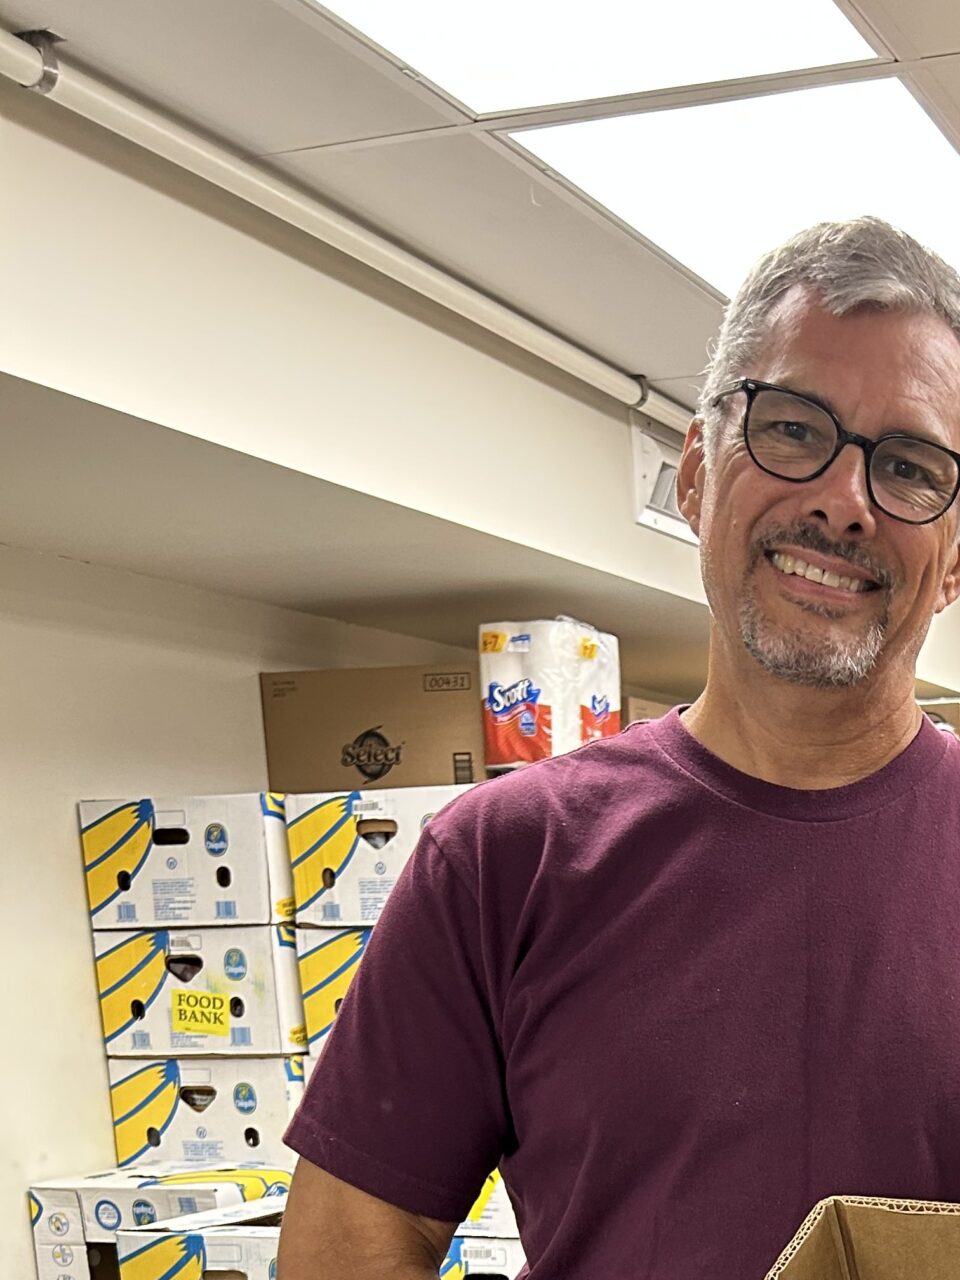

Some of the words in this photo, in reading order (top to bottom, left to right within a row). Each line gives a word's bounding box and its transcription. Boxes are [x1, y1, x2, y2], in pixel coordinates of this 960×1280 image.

[491, 679, 532, 712] Scott
[178, 993, 224, 1010] FOOD
[178, 1008, 224, 1026] BANK
